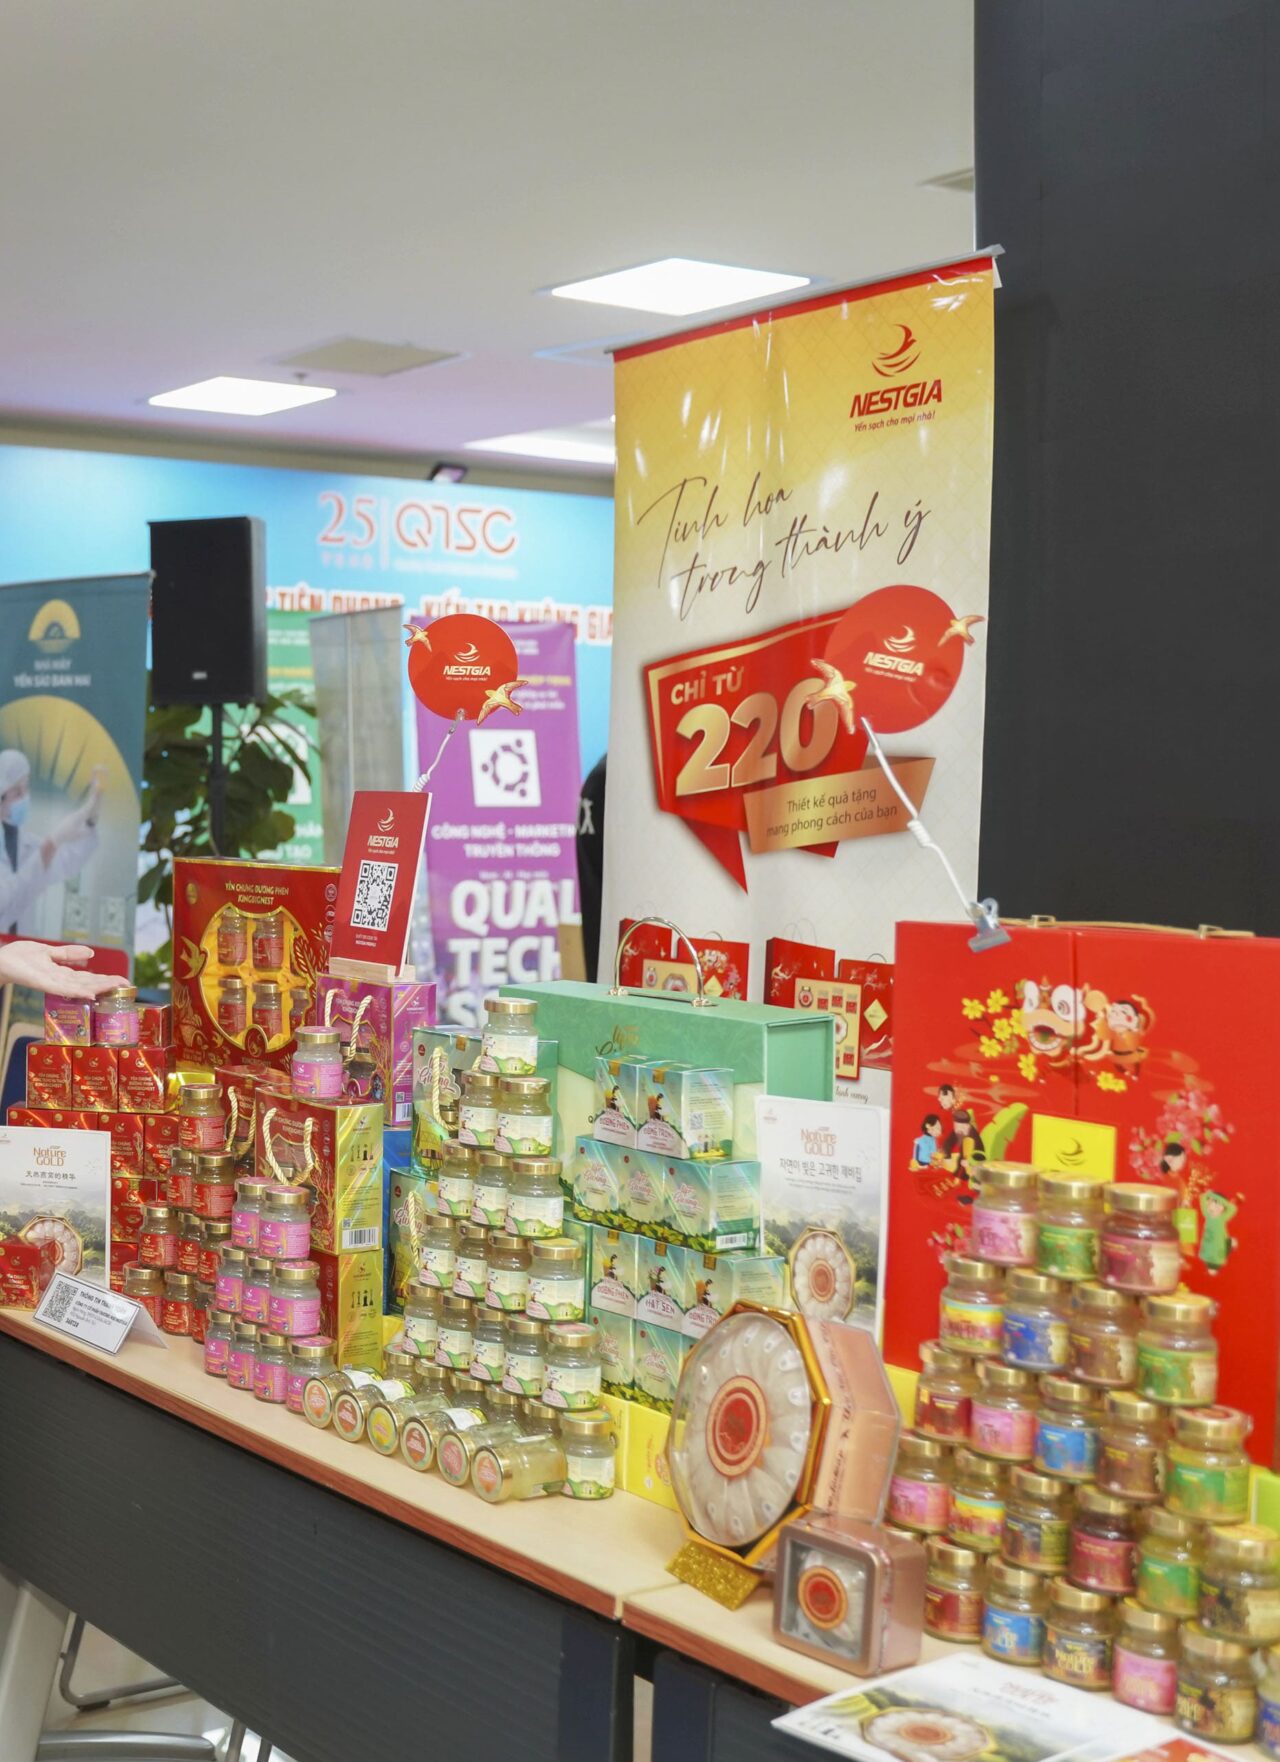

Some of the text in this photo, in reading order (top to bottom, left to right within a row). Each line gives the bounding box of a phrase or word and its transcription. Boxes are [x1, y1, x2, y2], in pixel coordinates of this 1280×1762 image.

[849, 379, 942, 418] NESTGIA
[868, 420, 884, 431] sạch
[886, 417, 899, 427] cho
[900, 414, 915, 425] mọi
[319, 492, 376, 547] 25
[396, 502, 517, 555] QTSC
[636, 472, 793, 588] Tinh hoa
[670, 491, 932, 621] trong thành ý
[443, 665, 492, 676] NESTGIA
[863, 651, 924, 676] NESTGIA
[671, 666, 745, 705] CHỈ TỪ
[675, 677, 839, 797] 220
[786, 788, 877, 815] Thiết kế quà tặng
[766, 804, 897, 839] mang phong cách của bạn
[367, 835, 399, 848] NESTGIA
[800, 1127, 837, 1144] Nature
[804, 1141, 835, 1157] GOLD
[33, 1146, 66, 1158] Nature
[36, 1156, 64, 1167] GOLD
